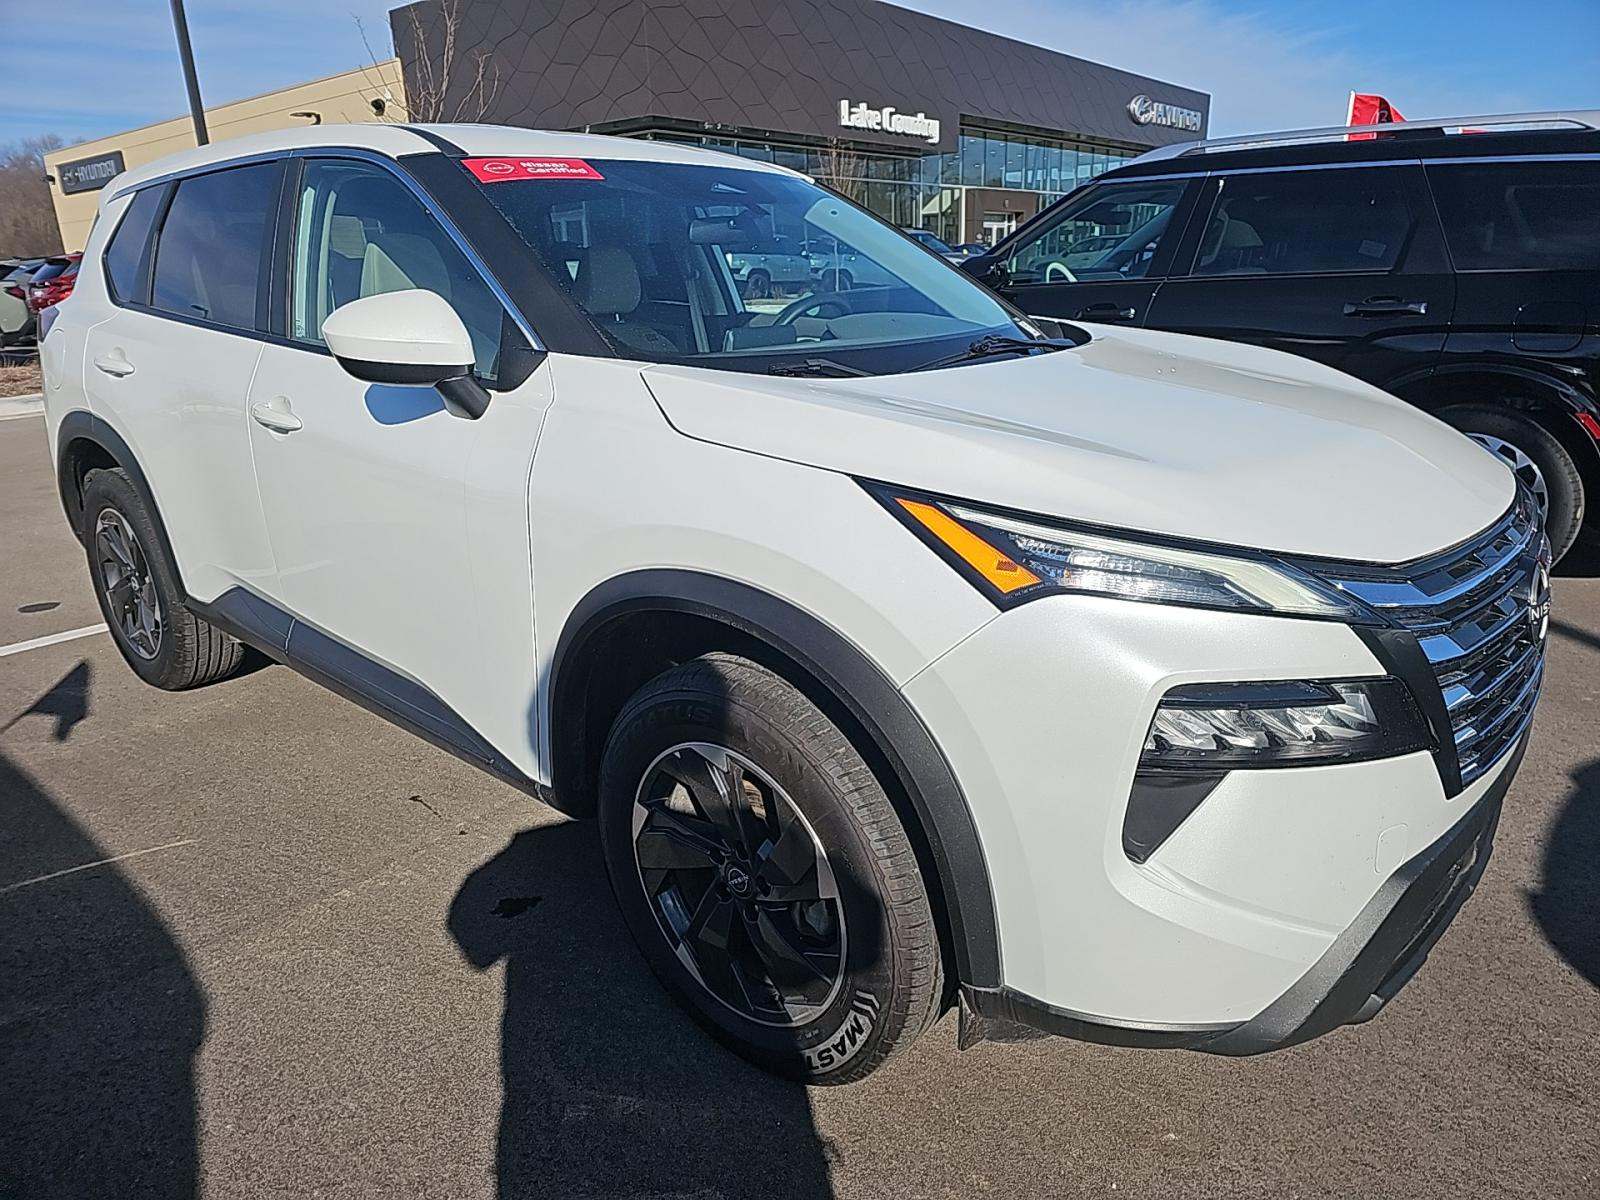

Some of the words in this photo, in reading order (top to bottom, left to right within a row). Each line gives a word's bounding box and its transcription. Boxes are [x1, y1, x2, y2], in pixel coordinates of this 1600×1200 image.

[840, 99, 881, 130] Lake
[882, 107, 940, 143] Country
[77, 160, 117, 182] HYUNDAI
[520, 161, 570, 169] Nissan
[526, 166, 589, 175] Certified
